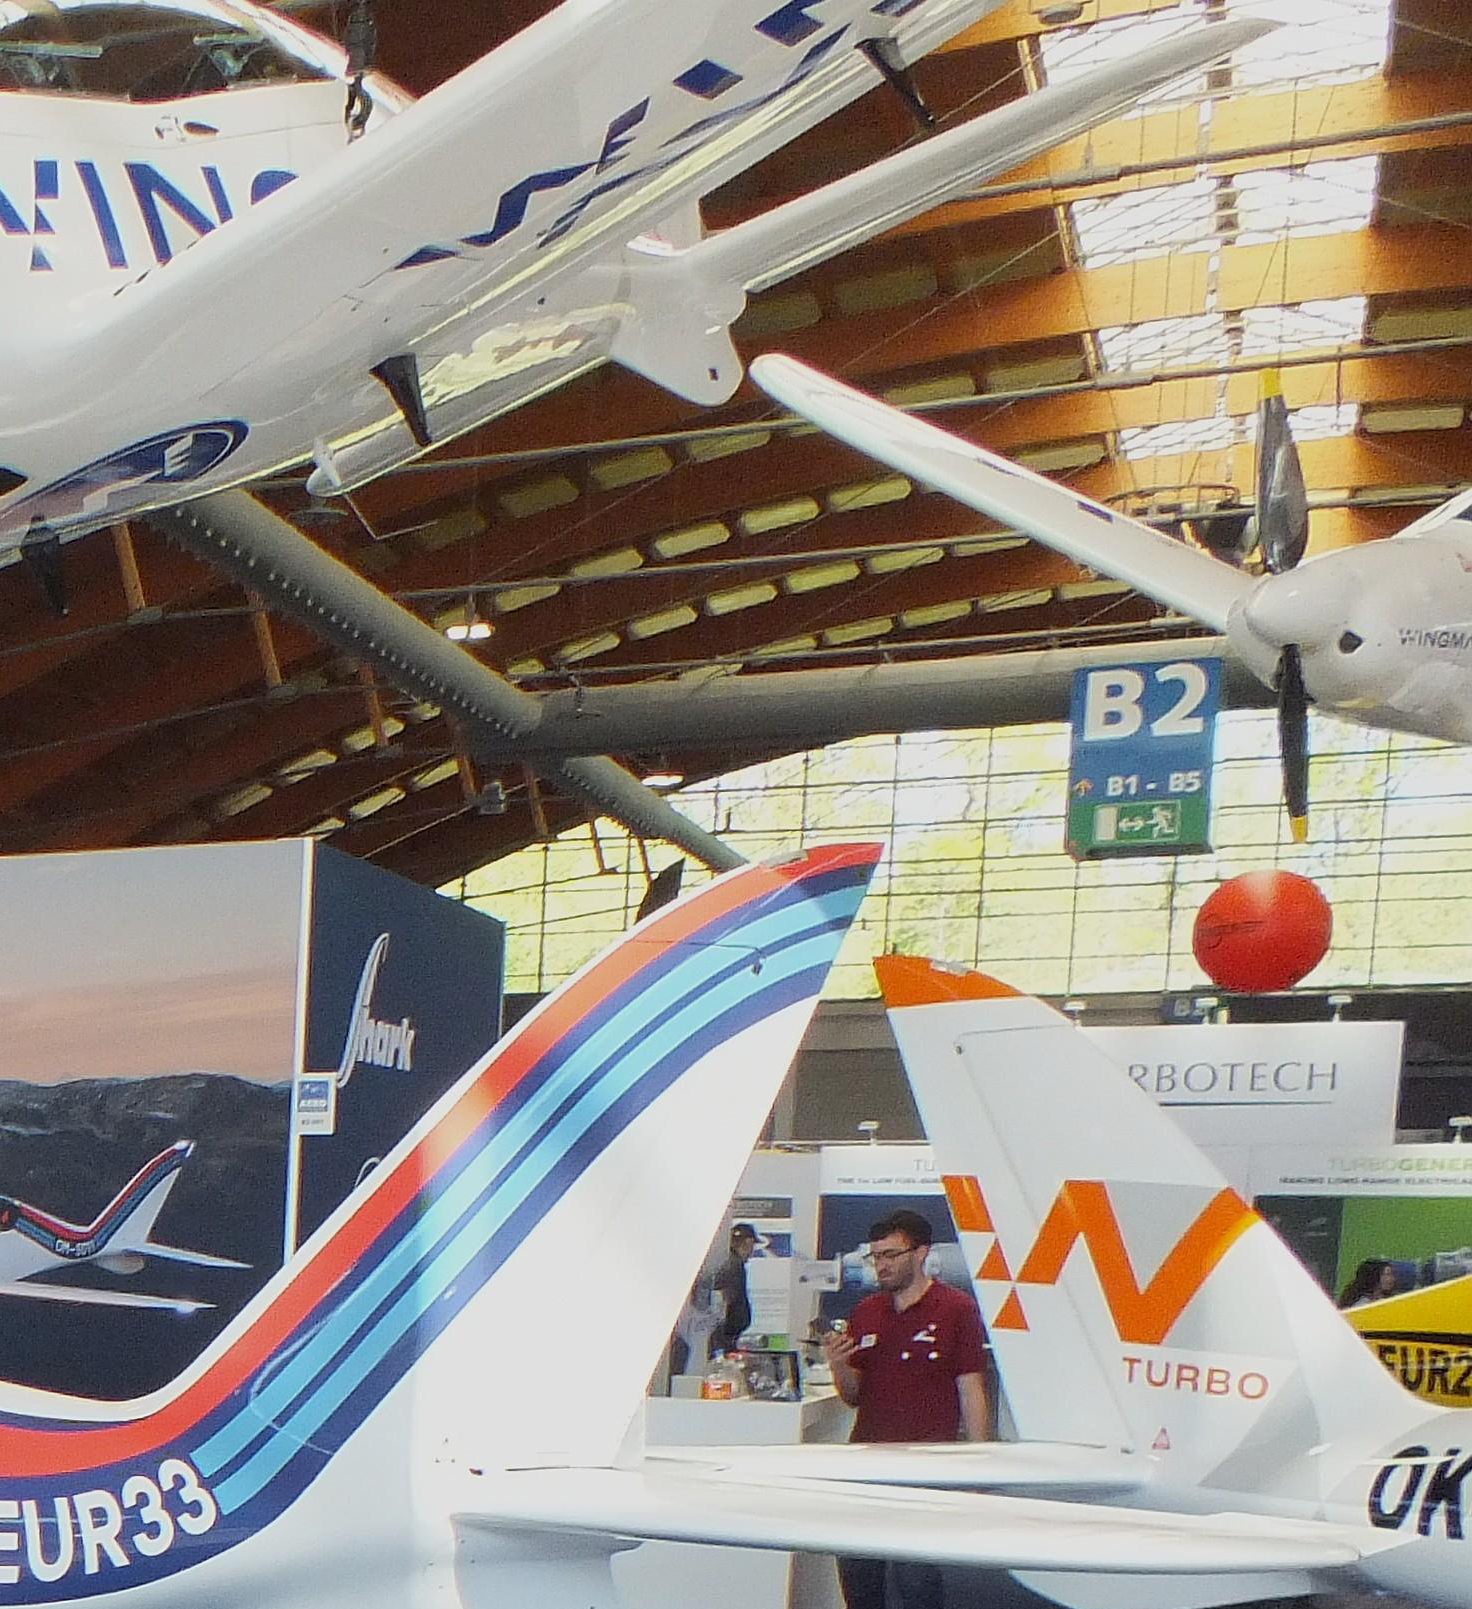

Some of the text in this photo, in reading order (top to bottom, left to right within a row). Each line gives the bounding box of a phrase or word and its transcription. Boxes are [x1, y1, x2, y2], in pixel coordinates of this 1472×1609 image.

[1083, 663, 1208, 741] B2
[1107, 775, 1140, 796] B1
[1169, 771, 1202, 793] B5
[1122, 1356, 1269, 1400] TURBO
